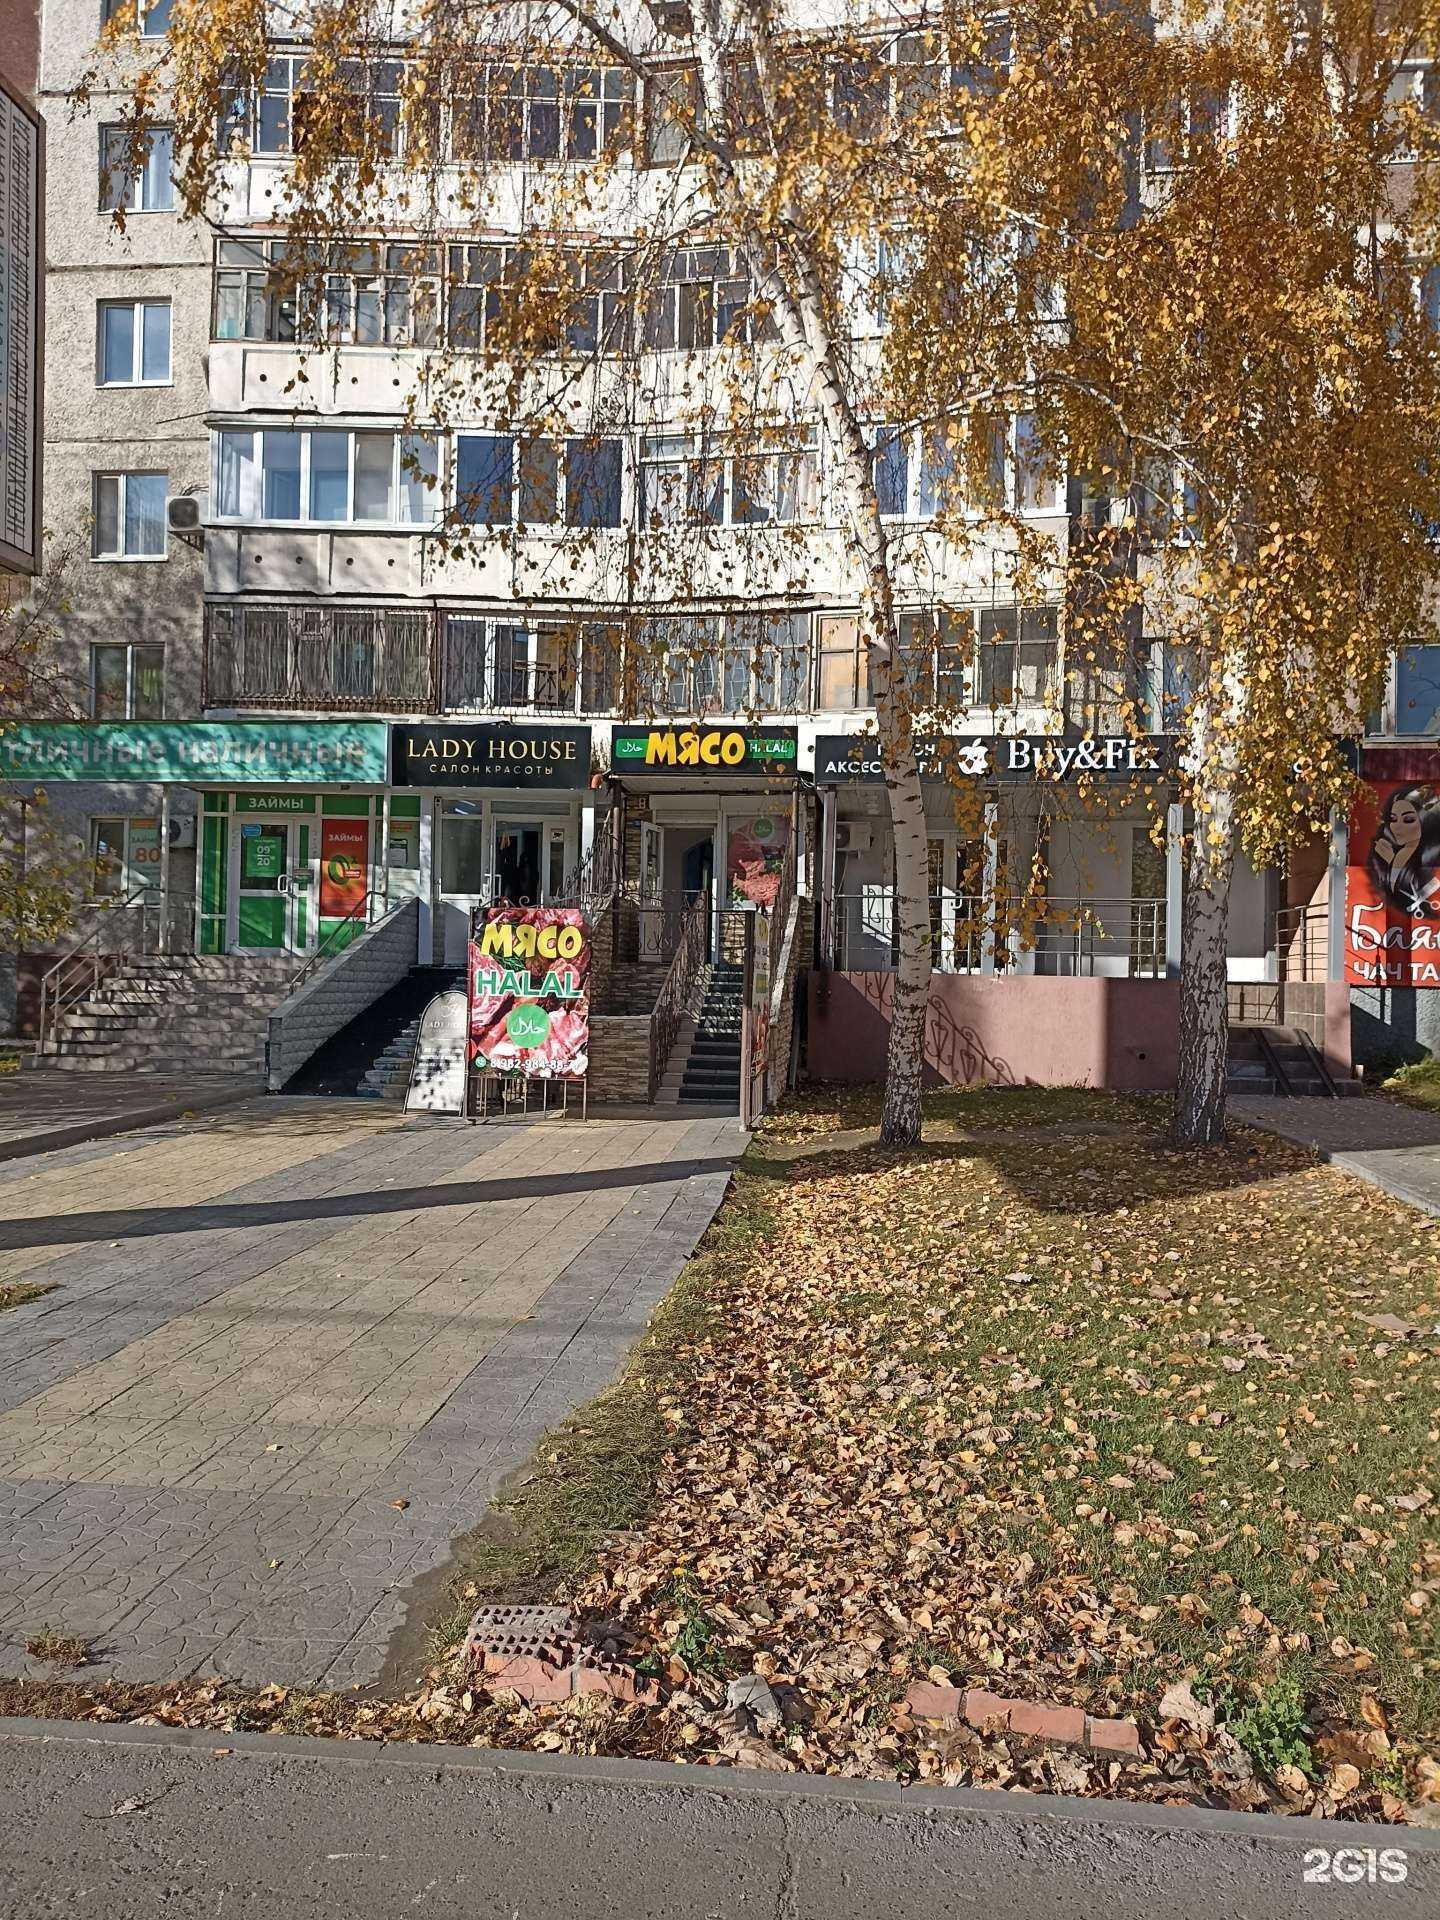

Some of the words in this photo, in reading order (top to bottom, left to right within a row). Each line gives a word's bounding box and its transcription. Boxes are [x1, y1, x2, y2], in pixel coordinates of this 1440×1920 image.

[10, 115, 31, 259] СПЕЦИАЛИСТА
[8, 254, 31, 409] КОНСУЛЬТАЦИЯ
[6, 407, 29, 539] НЕОБХОДИМА
[178, 738, 367, 765] наличные
[408, 739, 478, 758] LADY
[488, 740, 577, 760] HOUSE
[645, 732, 745, 765] МЯСО
[1007, 739, 1160, 776] Buy&Fix
[429, 764, 480, 773] САЛОН
[485, 766, 553, 775] КРАСОТЫ
[249, 796, 304, 809] ЗАЙМЫ
[328, 833, 363, 842] ЗАЙМЫ
[1351, 902, 1440, 951] Бая
[480, 923, 583, 959] МЯСО
[475, 970, 584, 998] HALAL
[1353, 961, 1402, 980] ЧАЧ
[510, 1015, 546, 1036] حلال
